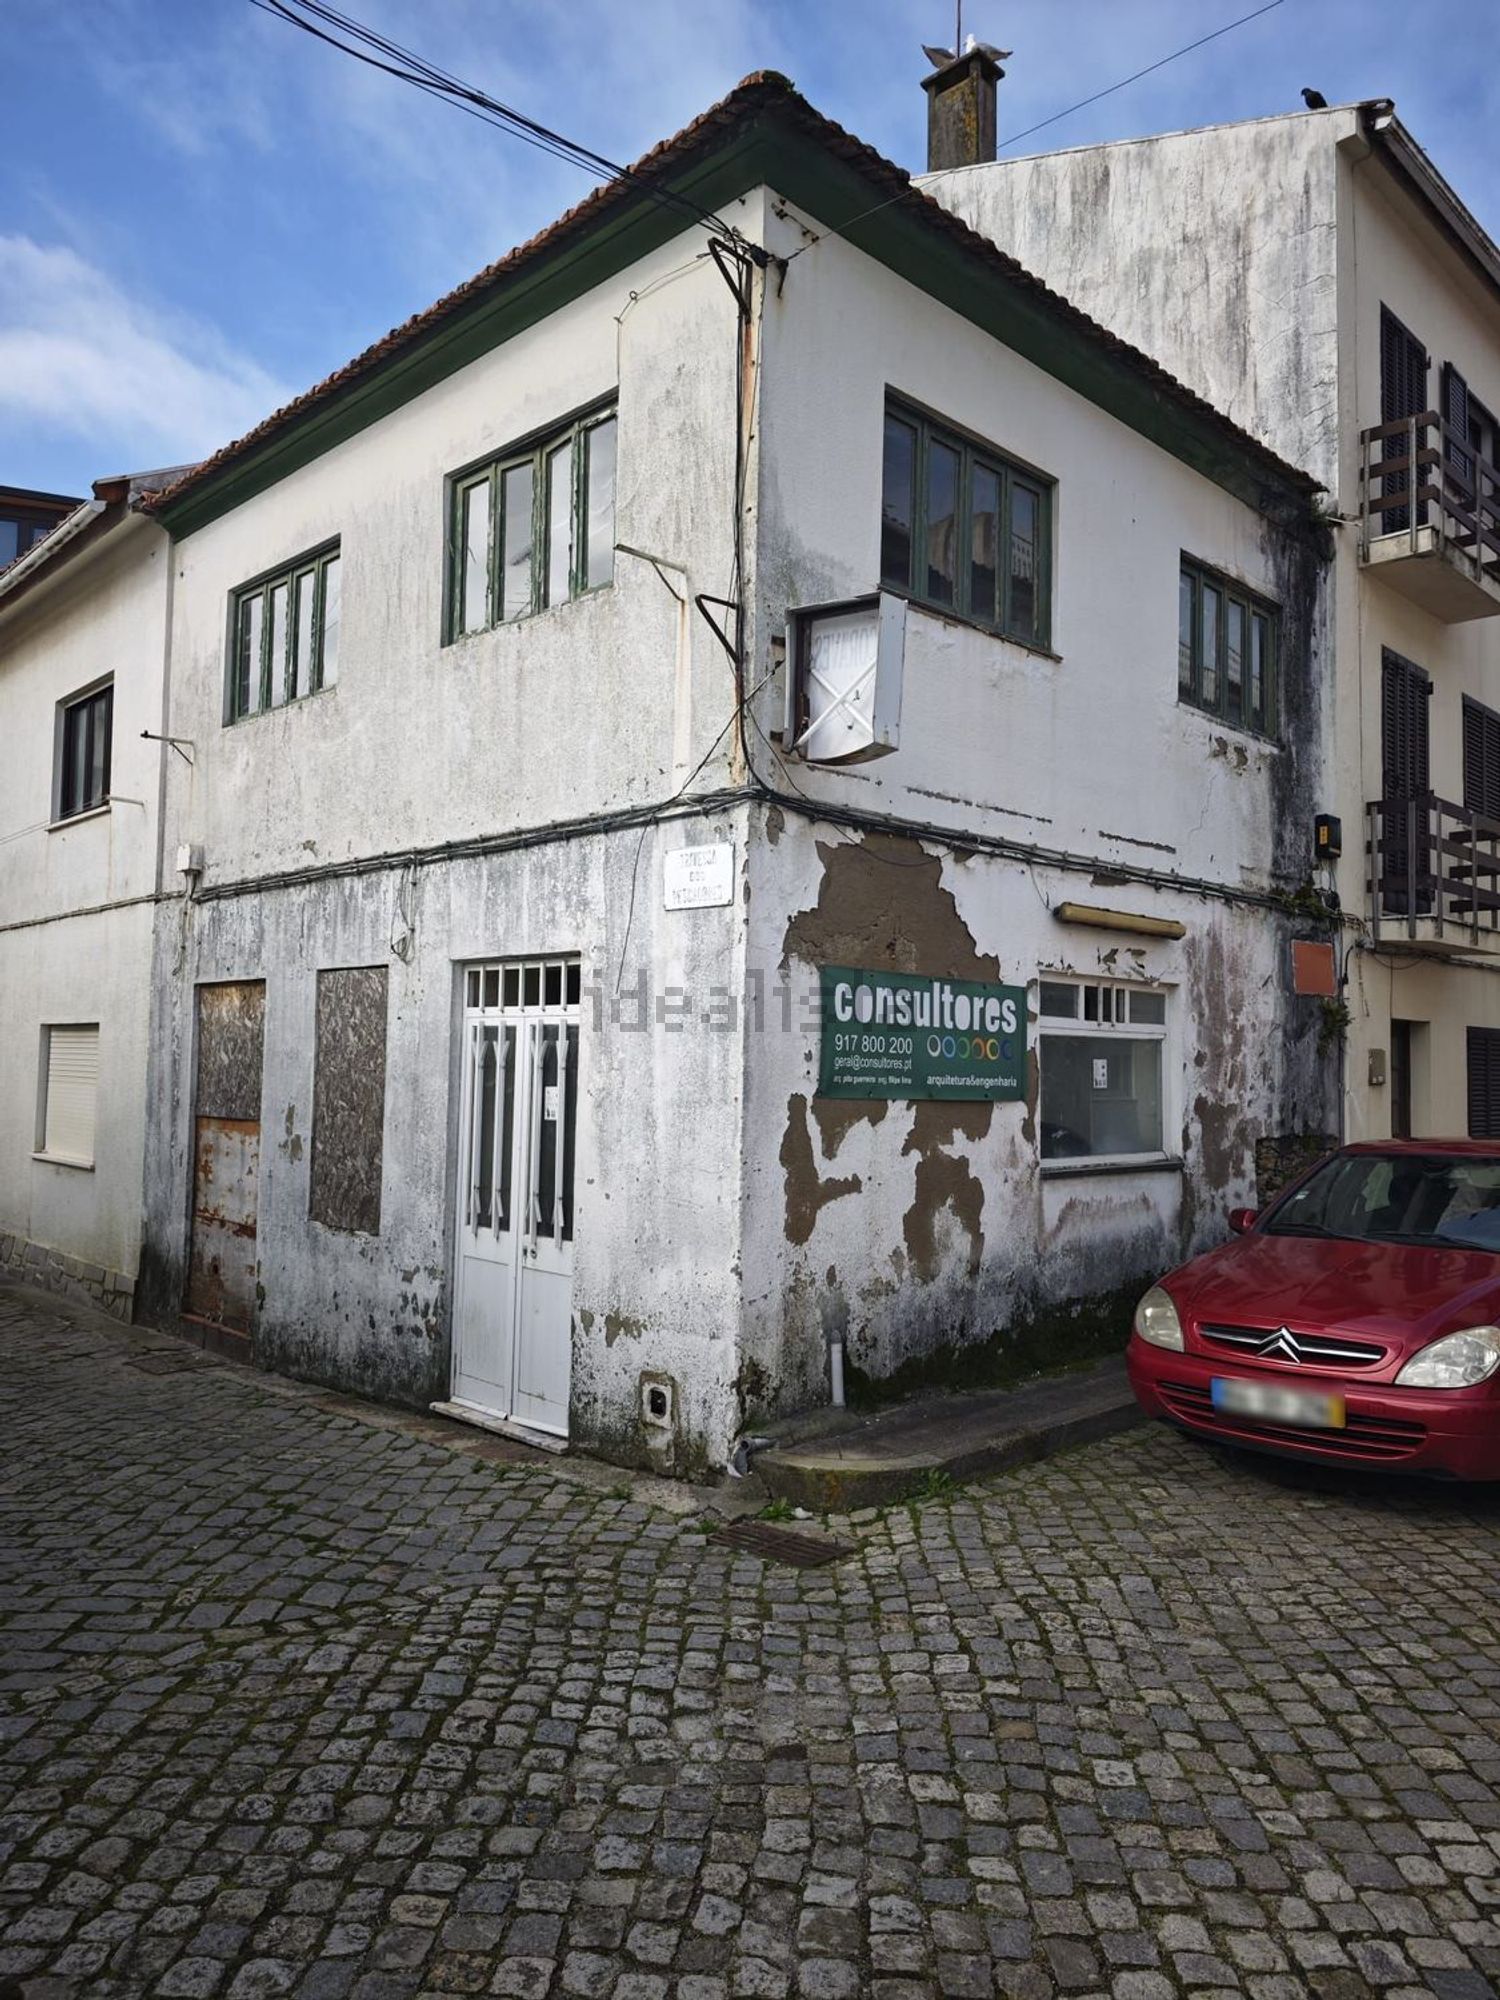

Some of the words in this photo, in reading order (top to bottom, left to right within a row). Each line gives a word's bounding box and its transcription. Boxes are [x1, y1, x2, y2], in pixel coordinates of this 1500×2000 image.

[834, 1033, 858, 1051] 917
[861, 1035, 885, 1053] 800
[889, 1036, 913, 1054] 200
[834, 1054, 912, 1073] geral@consultores.pt
[926, 1074, 1018, 1090] arquitetura&engenharia
